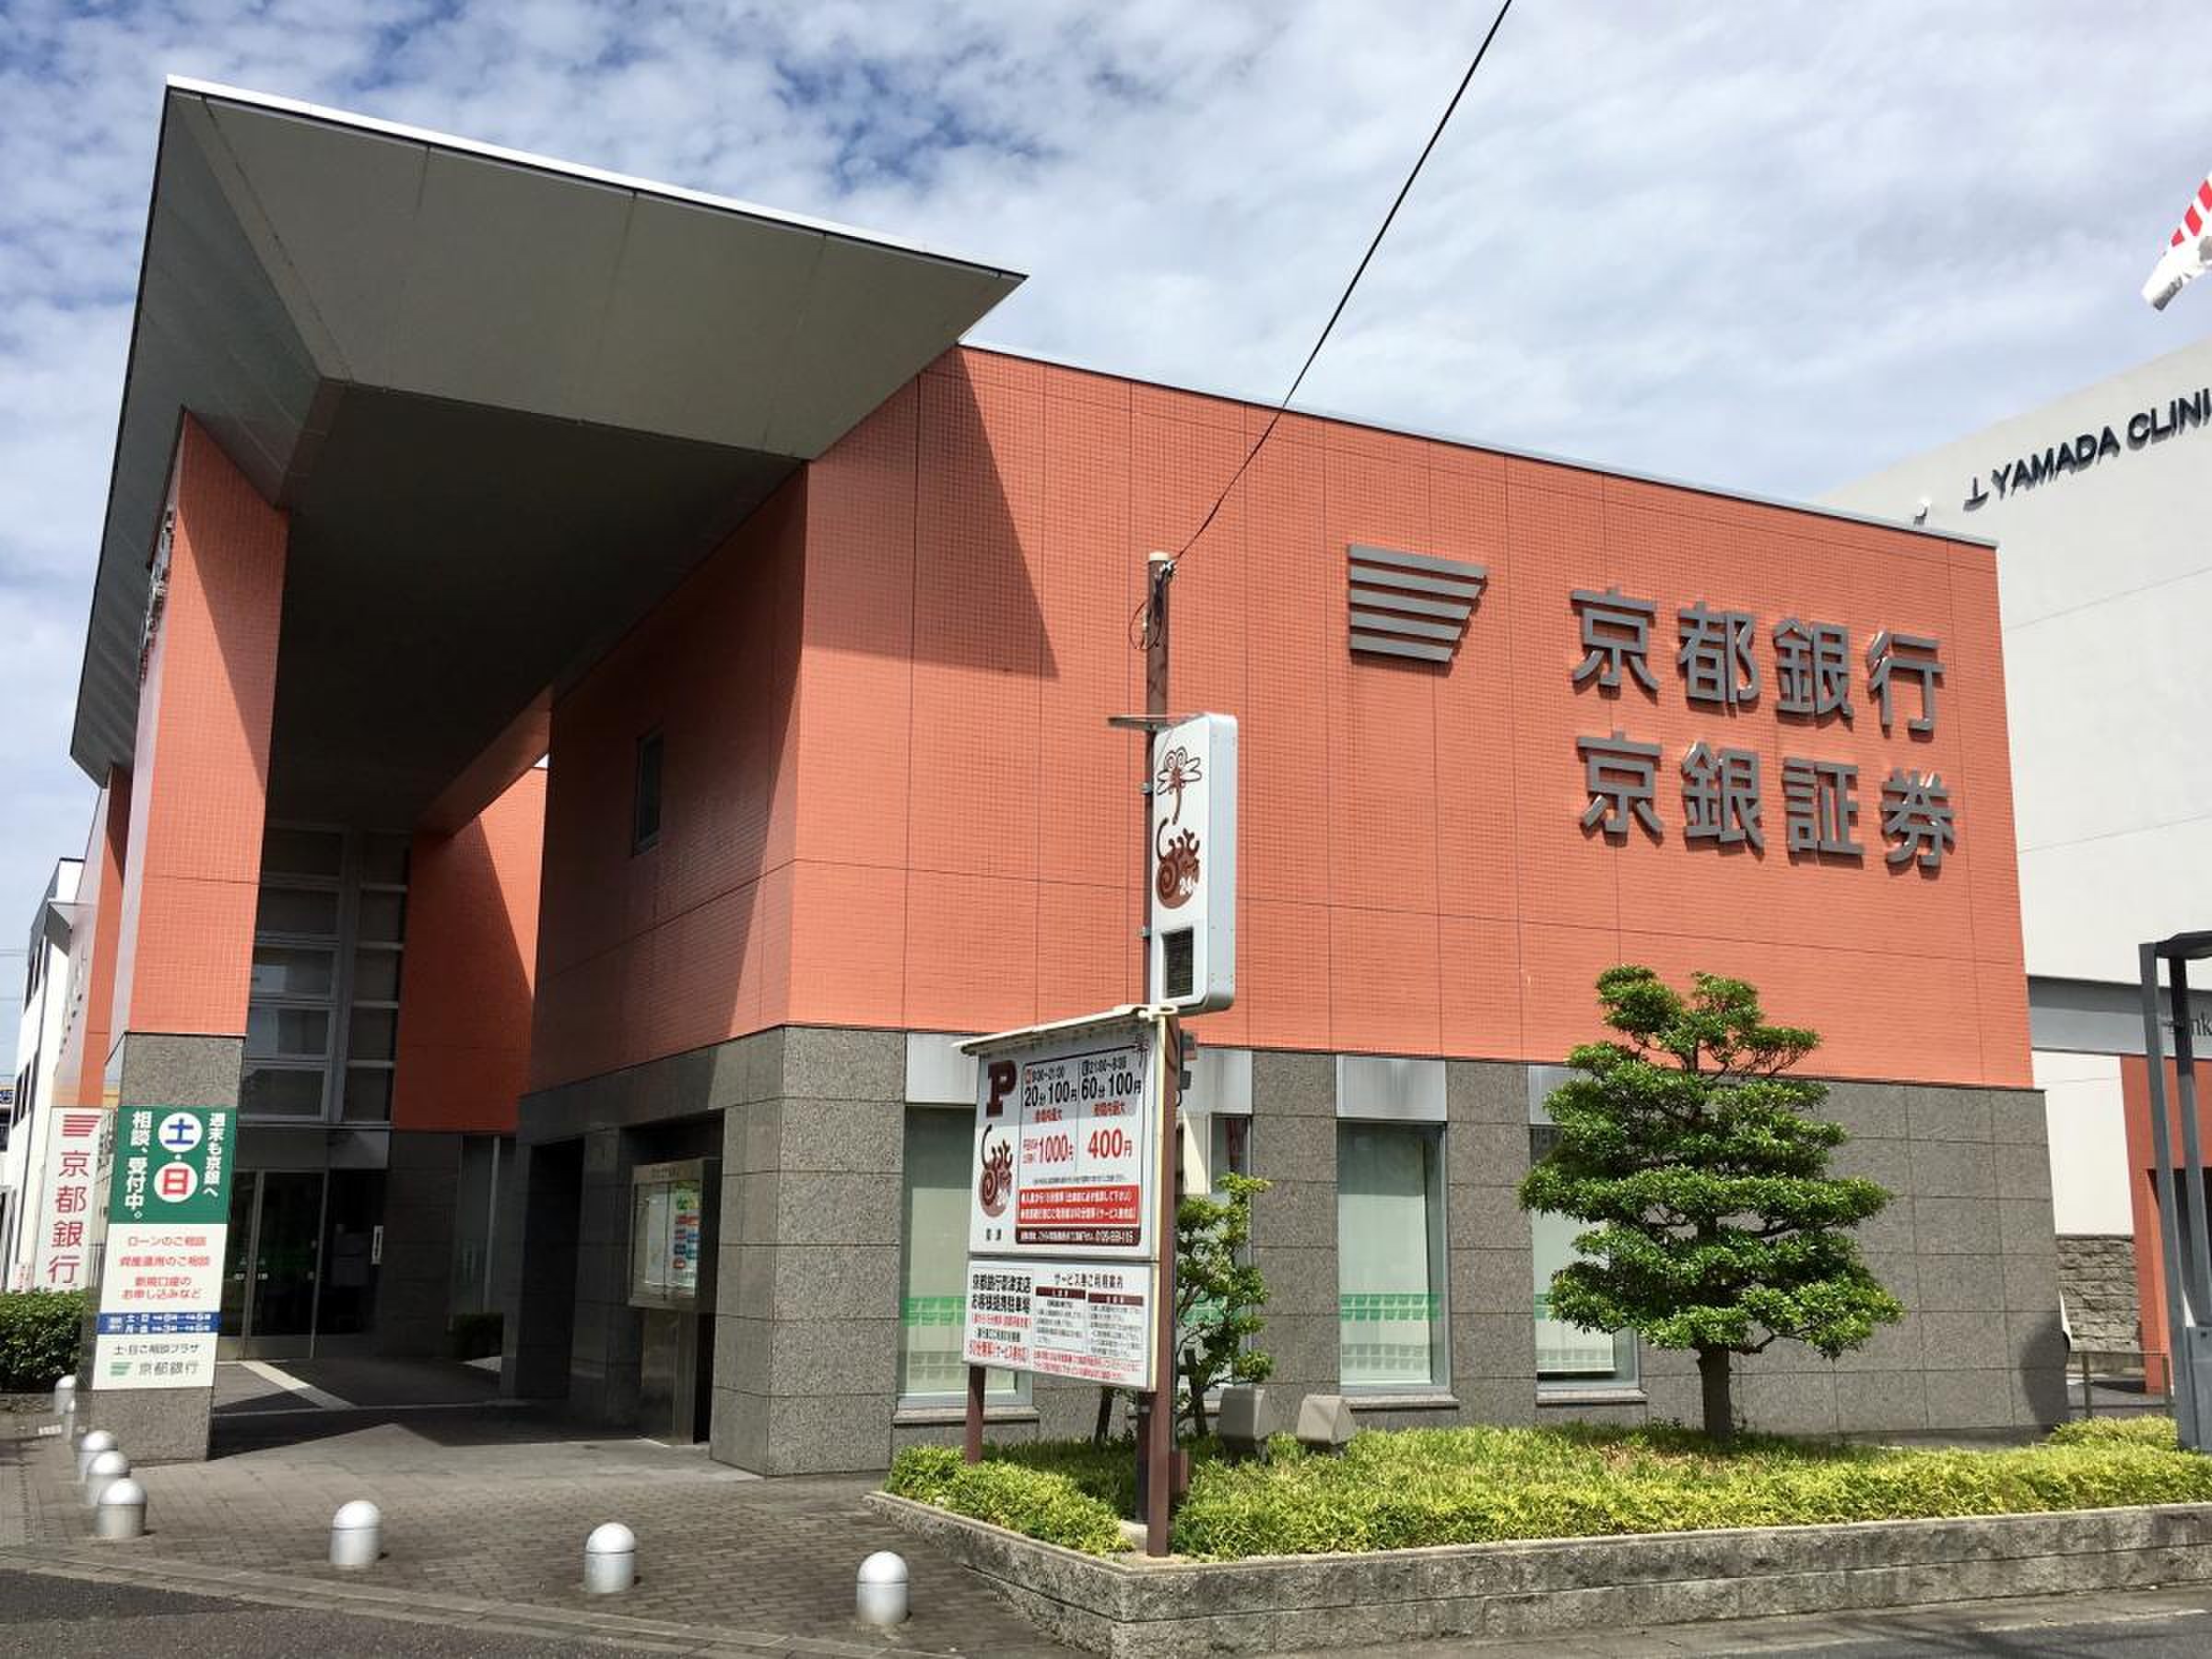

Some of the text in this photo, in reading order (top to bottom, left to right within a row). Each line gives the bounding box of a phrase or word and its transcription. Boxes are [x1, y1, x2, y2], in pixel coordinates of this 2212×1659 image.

[1992, 426, 2120, 499] YAMADA
[1571, 587, 1946, 737] 京都銀行
[1577, 731, 1958, 879] 京銀証券
[986, 1061, 1018, 1118] P
[1088, 1128, 1133, 1159] 400円
[47, 1150, 91, 1284] 京都銀行
